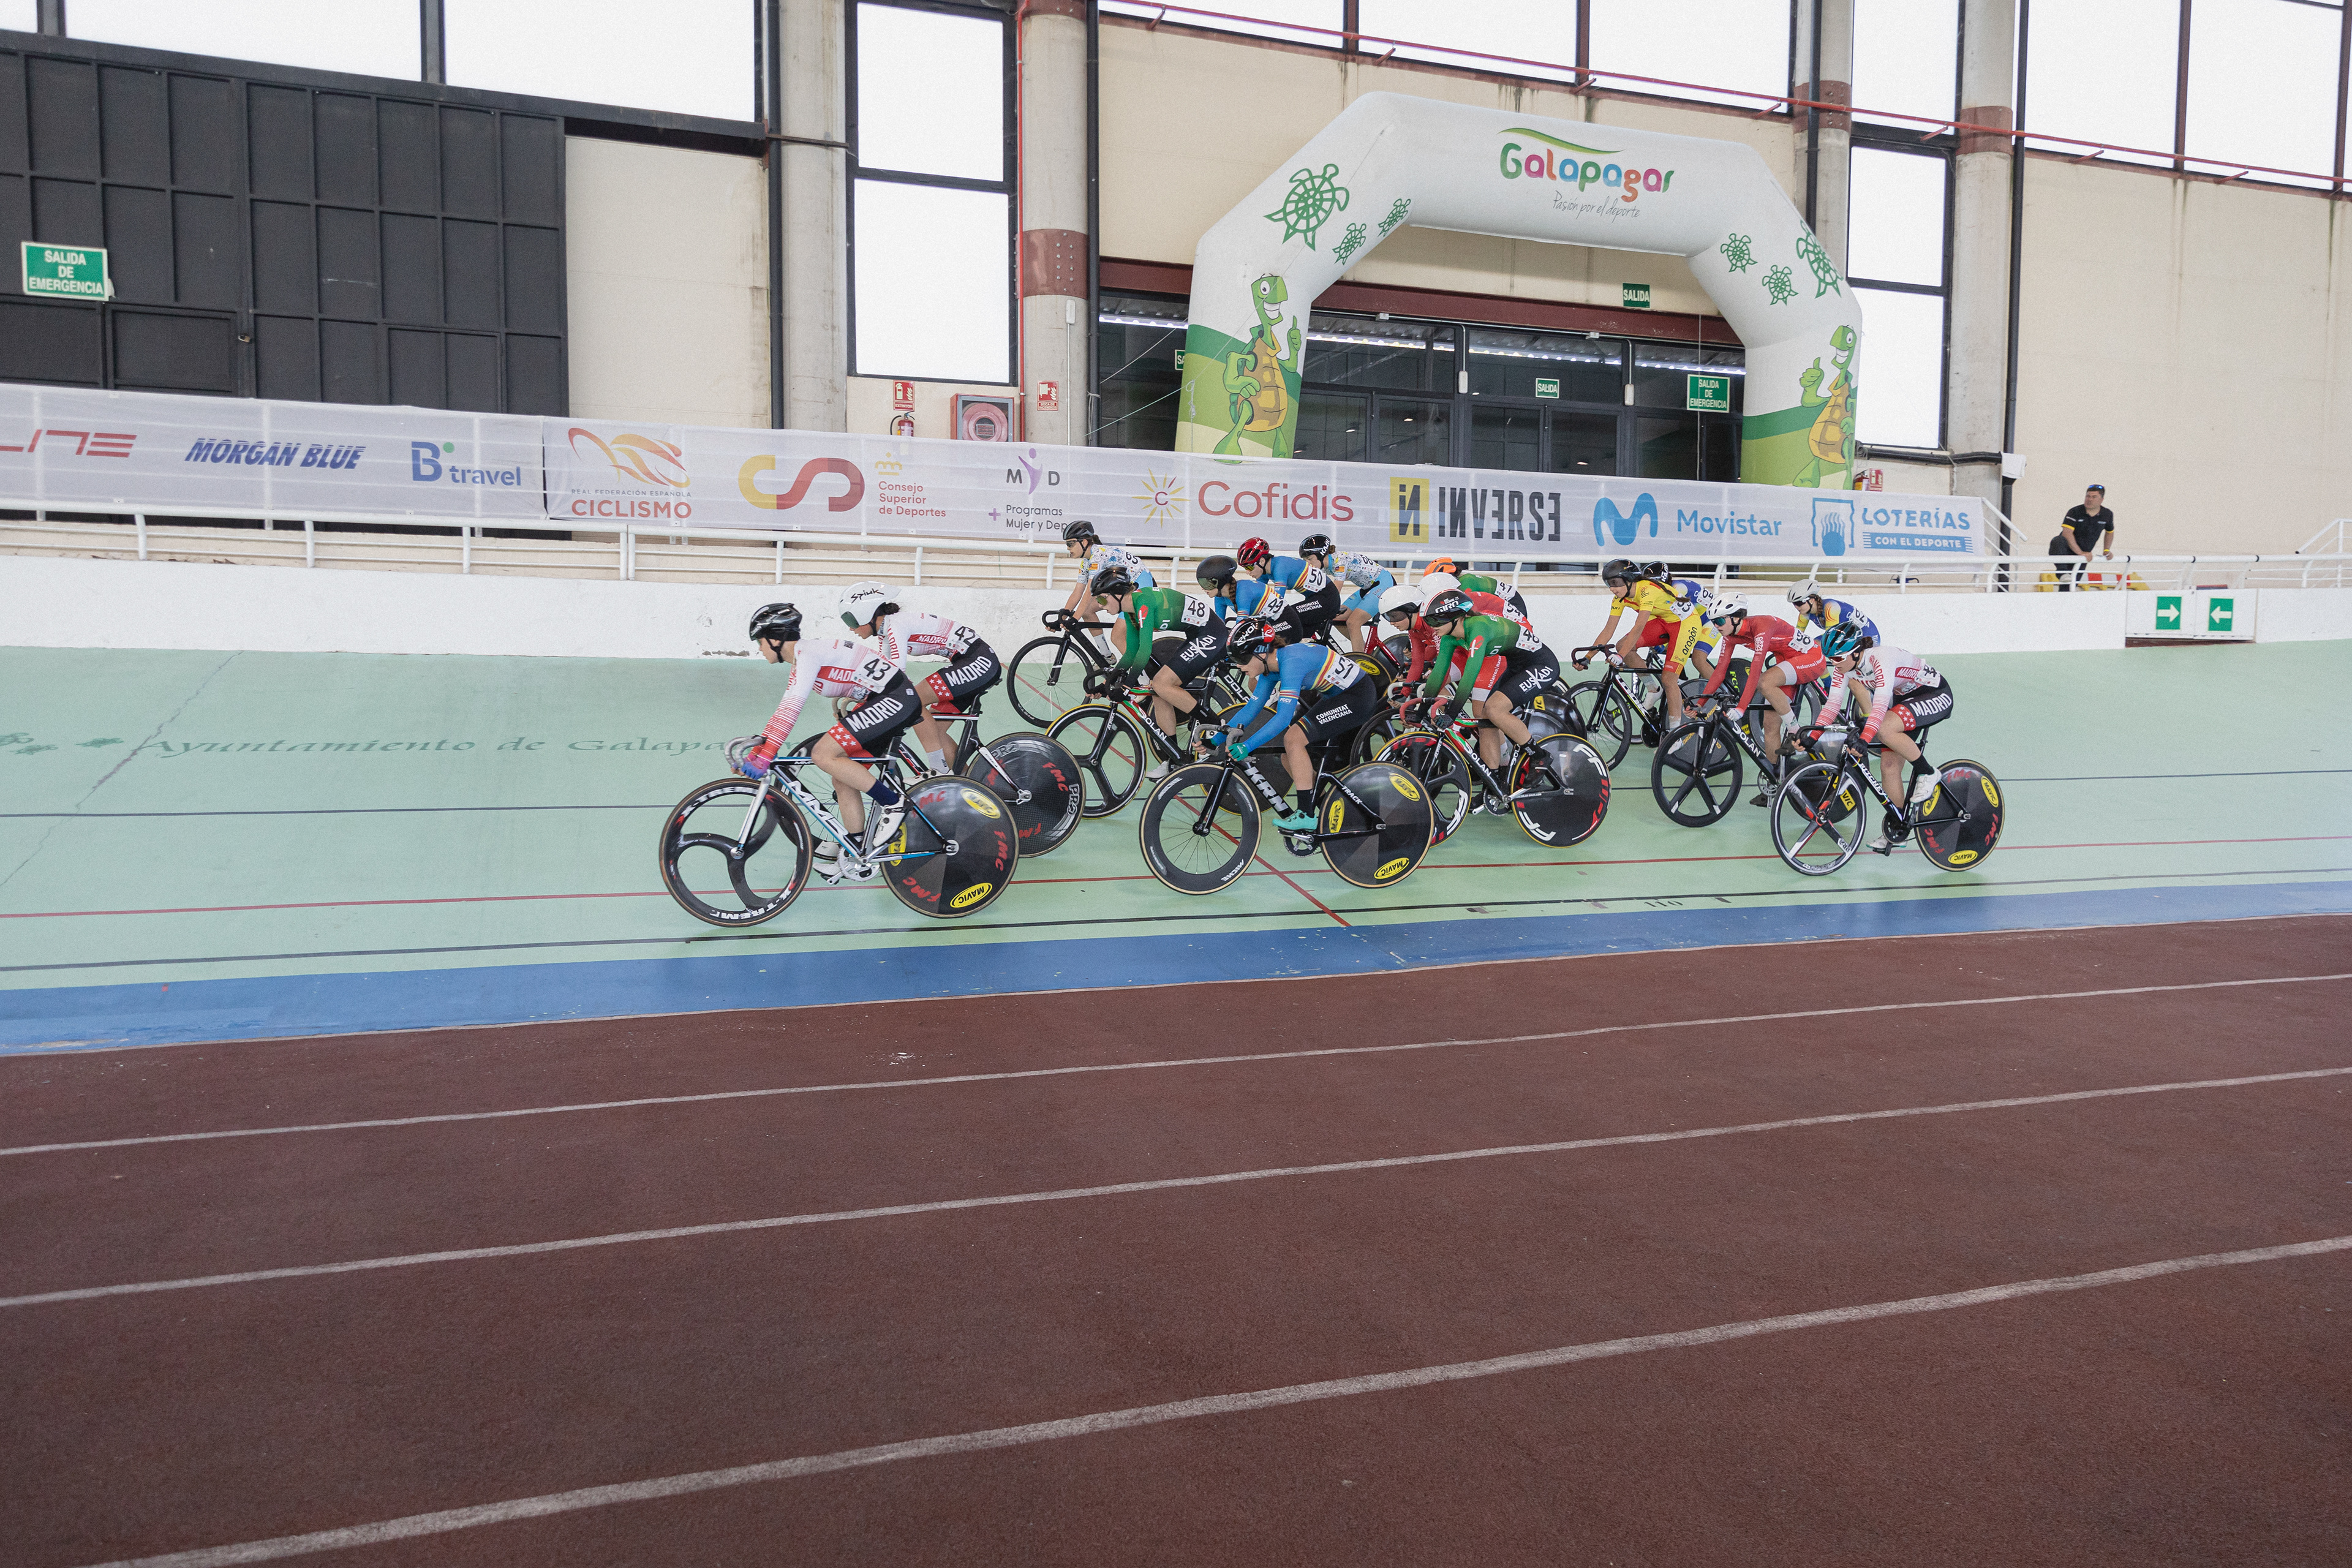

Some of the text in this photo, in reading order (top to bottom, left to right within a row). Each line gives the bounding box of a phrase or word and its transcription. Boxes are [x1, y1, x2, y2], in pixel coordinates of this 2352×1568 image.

[1499, 142, 1675, 203] Galapagar
[1553, 190, 1640, 222] Pasión por el deporte
[44, 250, 86, 265] SALIDA
[58, 266, 74, 278] DE
[29, 277, 104, 294] EMERGENCIA
[1623, 289, 1649, 302] SALIDA
[1537, 383, 1558, 393] SALIDA
[1698, 379, 1719, 388] SALIDA
[1690, 398, 1727, 409] EMERGENCIA
[184, 437, 366, 470] MORGAN BLUE
[450, 466, 522, 486] travel
[878, 481, 924, 492] Consejo
[879, 493, 927, 505] Superior
[1198, 480, 1354, 522] Cofidis
[571, 499, 692, 519] CICLISMO
[879, 505, 946, 518] de Deportes
[1006, 504, 1063, 517] Programas
[1861, 507, 1970, 530] LOTERÍAS
[1006, 518, 1035, 531] Mujer
[1038, 522, 1043, 532] y
[1677, 509, 1782, 537] Movistar
[1875, 537, 1962, 548] CON EL DEPORTE
[1309, 570, 1323, 586] 50
[1188, 600, 1205, 617] 48
[1268, 598, 1284, 613] 49
[1295, 600, 1319, 609] COMUNITAT
[1297, 604, 1322, 613] VALENCIANA
[1435, 600, 1459, 613] GIRO
[954, 625, 976, 644] 42
[1273, 624, 1292, 633] ENCIANA
[1180, 635, 1217, 662] EUSKADI
[864, 658, 891, 681] 43
[945, 655, 992, 687] MADRID
[1335, 657, 1354, 679] 51
[1223, 674, 1250, 703] DOLA
[1519, 666, 1553, 693] EUSKADI
[845, 696, 903, 733] MADRID
[1316, 704, 1349, 721] COMUNITAT
[1909, 693, 1952, 717] MADRID
[1138, 706, 1167, 741] DOLAN
[1318, 709, 1353, 725] VALENCIANA
[132, 739, 476, 758] Ayuntamiento
[497, 737, 546, 751] de
[1732, 720, 1761, 758] DOLAN
[1464, 741, 1491, 777] DOLAN
[1042, 762, 1069, 792] FMC
[1244, 766, 1289, 812] KRN
[1342, 785, 1363, 804] TRACK
[1984, 782, 1996, 802] MAVIC
[994, 830, 1009, 872] FMC
[1953, 853, 1973, 861] MAVIC
[1221, 859, 1245, 882] MICHE
[1380, 860, 1404, 876] MAVIC
[902, 876, 942, 902] FMC
[959, 885, 986, 903] MAVIC
